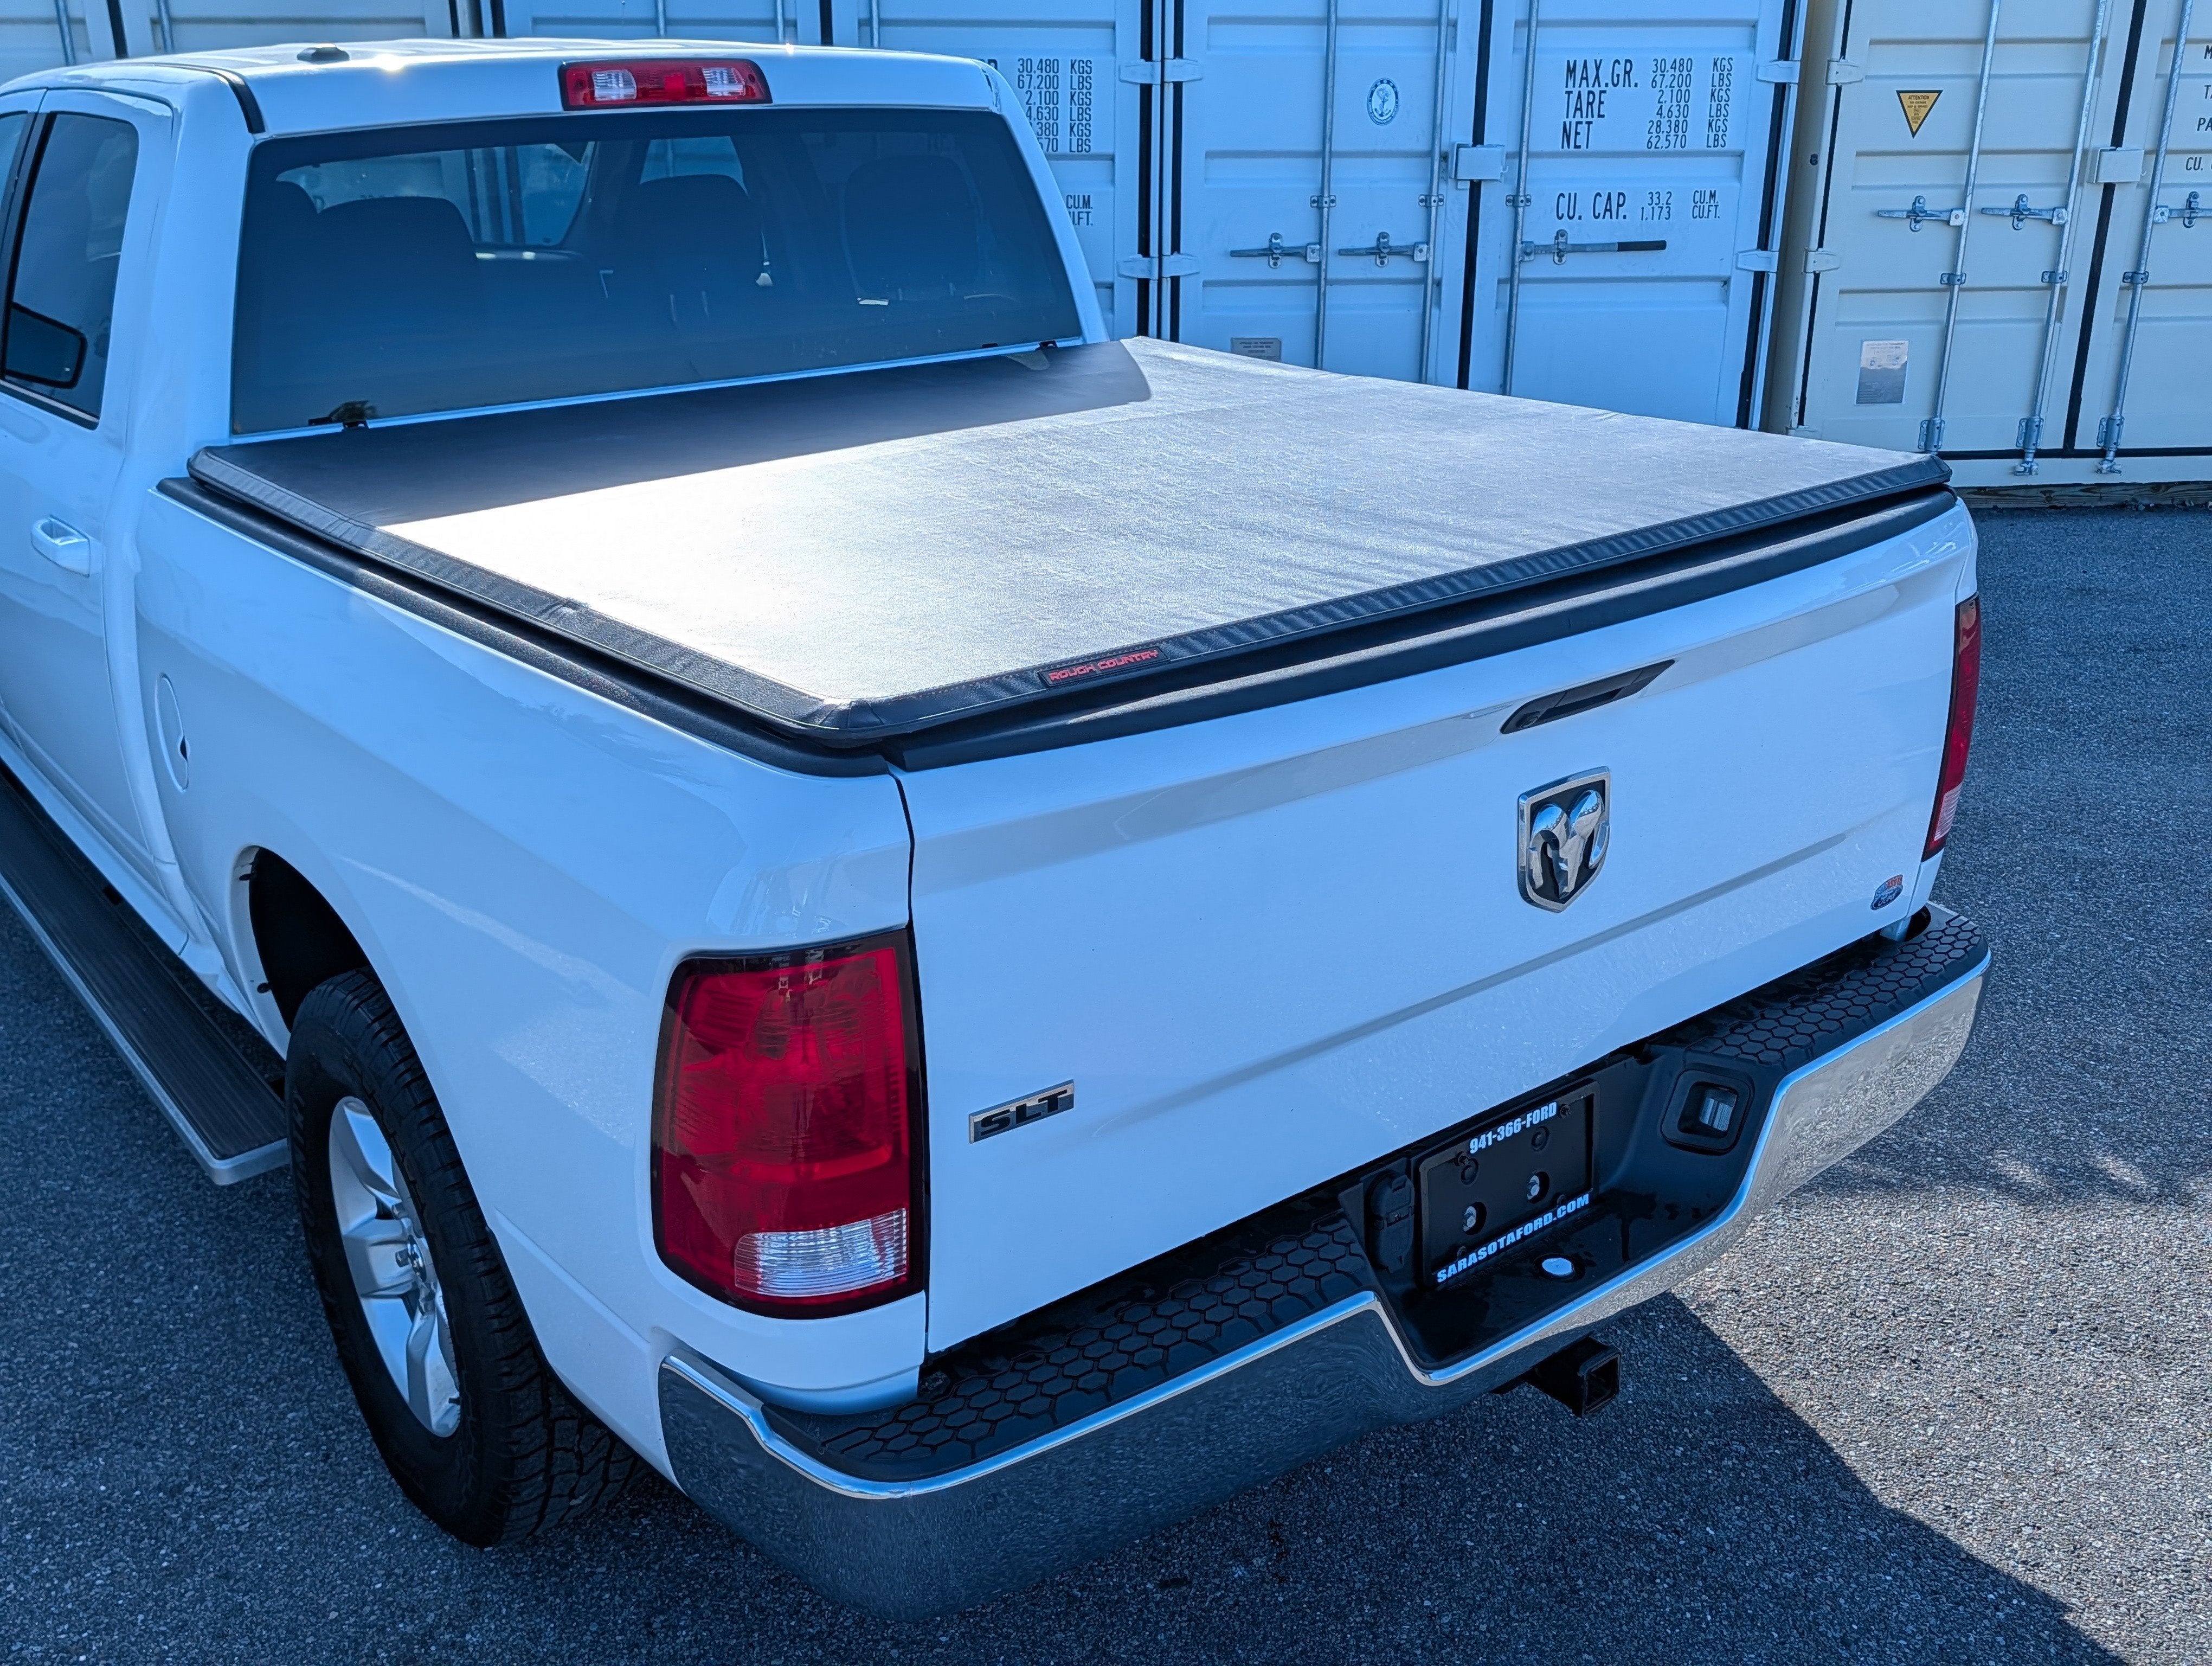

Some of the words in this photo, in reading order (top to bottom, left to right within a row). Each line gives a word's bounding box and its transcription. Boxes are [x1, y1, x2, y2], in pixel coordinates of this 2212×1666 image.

[1070, 59, 1092, 74] KGS
[1565, 59, 1638, 88] MAX.GR.
[1713, 57, 1733, 72] KGS
[1070, 75, 1092, 90] LBS
[1711, 73, 1732, 87] LBS
[1070, 91, 1092, 106] KGS
[1565, 90, 1607, 118] TARE
[1710, 88, 1731, 102] KGS
[1070, 107, 1091, 121] LBS
[1709, 104, 1729, 118] LBS
[1070, 122, 1091, 137] KGS
[1561, 121, 1593, 149] NET
[1707, 119, 1728, 133] KGS
[1069, 137, 1091, 152] LBS
[1706, 134, 1726, 148] LBS
[2185, 157, 2203, 171] CU.
[1066, 195, 1093, 209] CU.M.
[1556, 193, 1582, 220] CU.
[1592, 192, 1626, 220] CAP.
[1648, 191, 1672, 206] 33.2
[1693, 190, 1719, 204] CU.M.
[1692, 205, 1720, 219] CU.FT.
[1049, 664, 1096, 681] ROUGH
[1097, 650, 1158, 670] COUNTRY
[980, 1089, 1068, 1136] SLT
[1469, 1101, 1557, 1154] 941-366-FORD
[1437, 1193, 1590, 1283] SARASOTAFORD.COM
